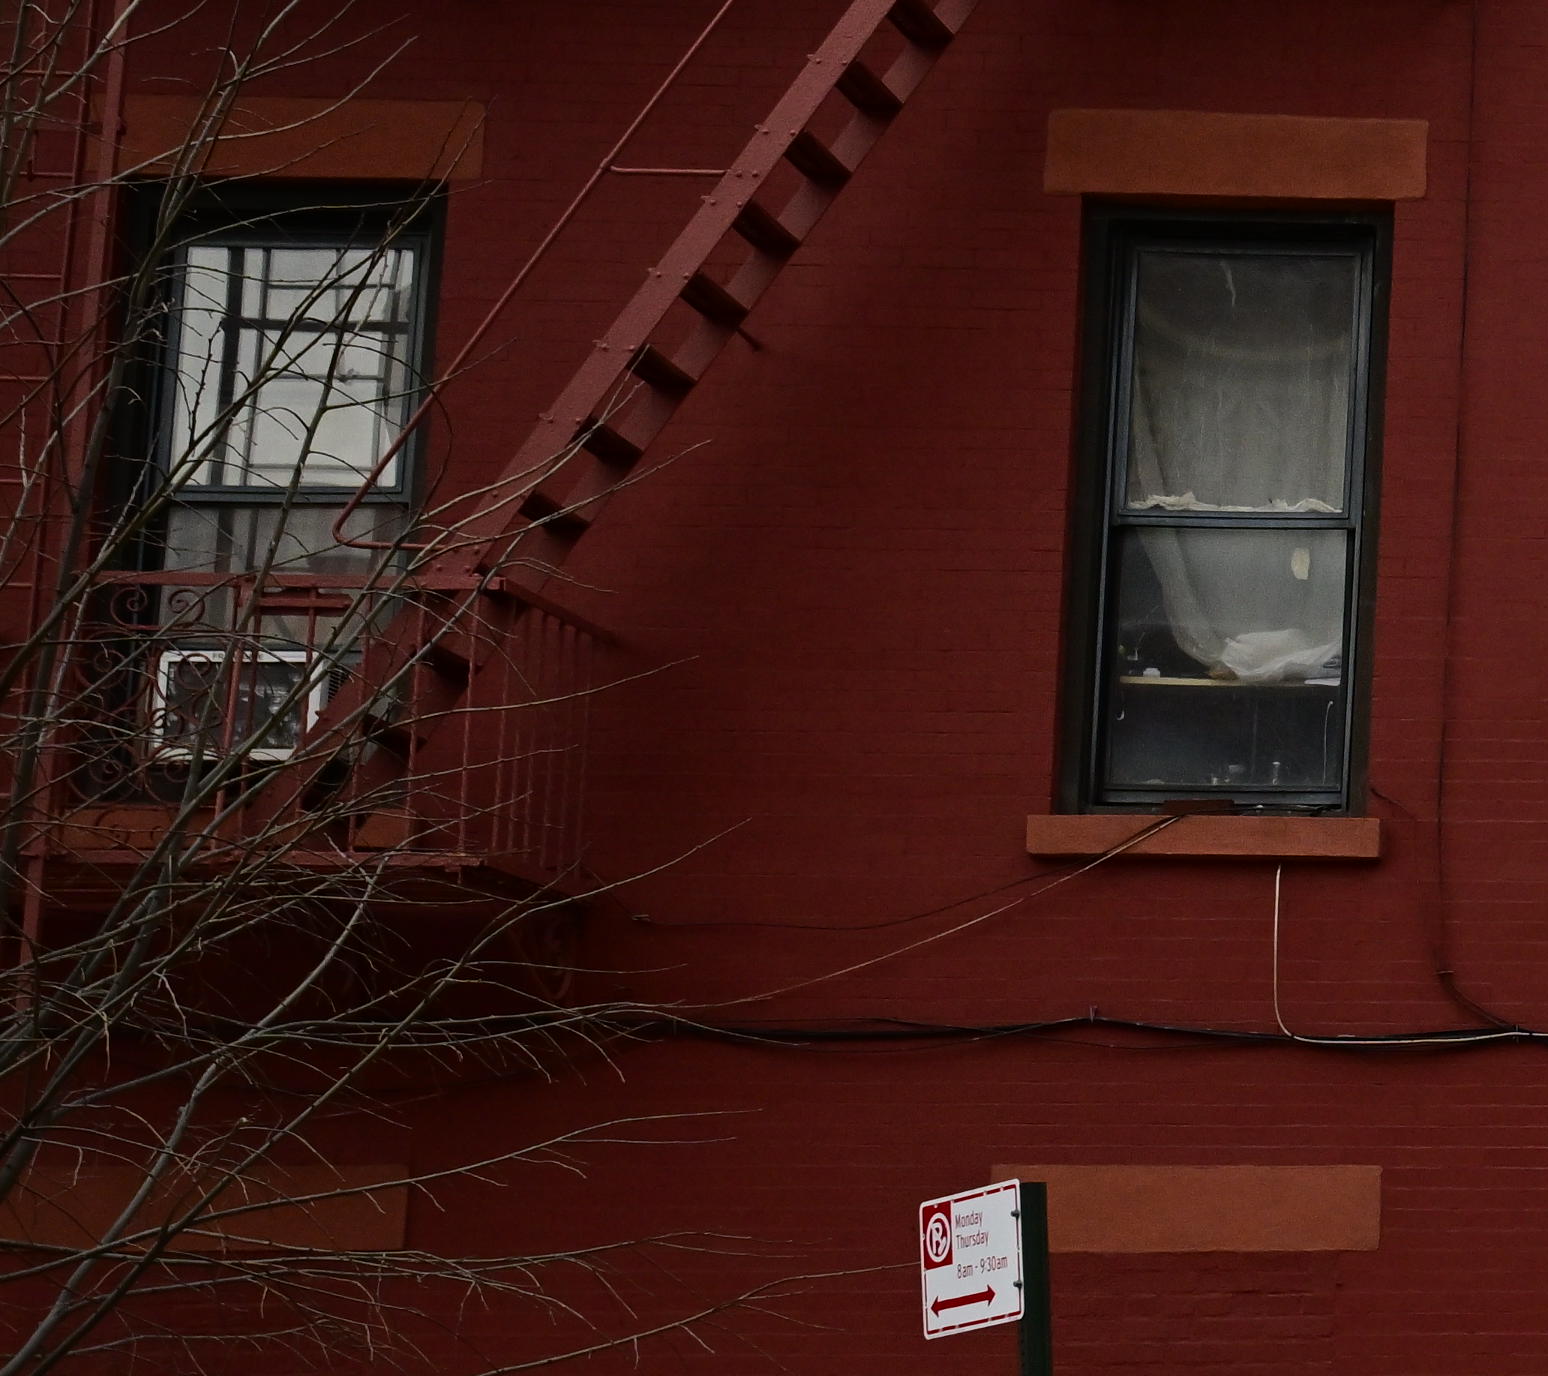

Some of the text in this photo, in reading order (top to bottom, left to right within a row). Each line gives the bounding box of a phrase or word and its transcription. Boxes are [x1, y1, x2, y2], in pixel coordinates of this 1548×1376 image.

[955, 1210, 983, 1229] Monday
[956, 1229, 989, 1250] Thursday
[957, 1263, 974, 1280] 8am
